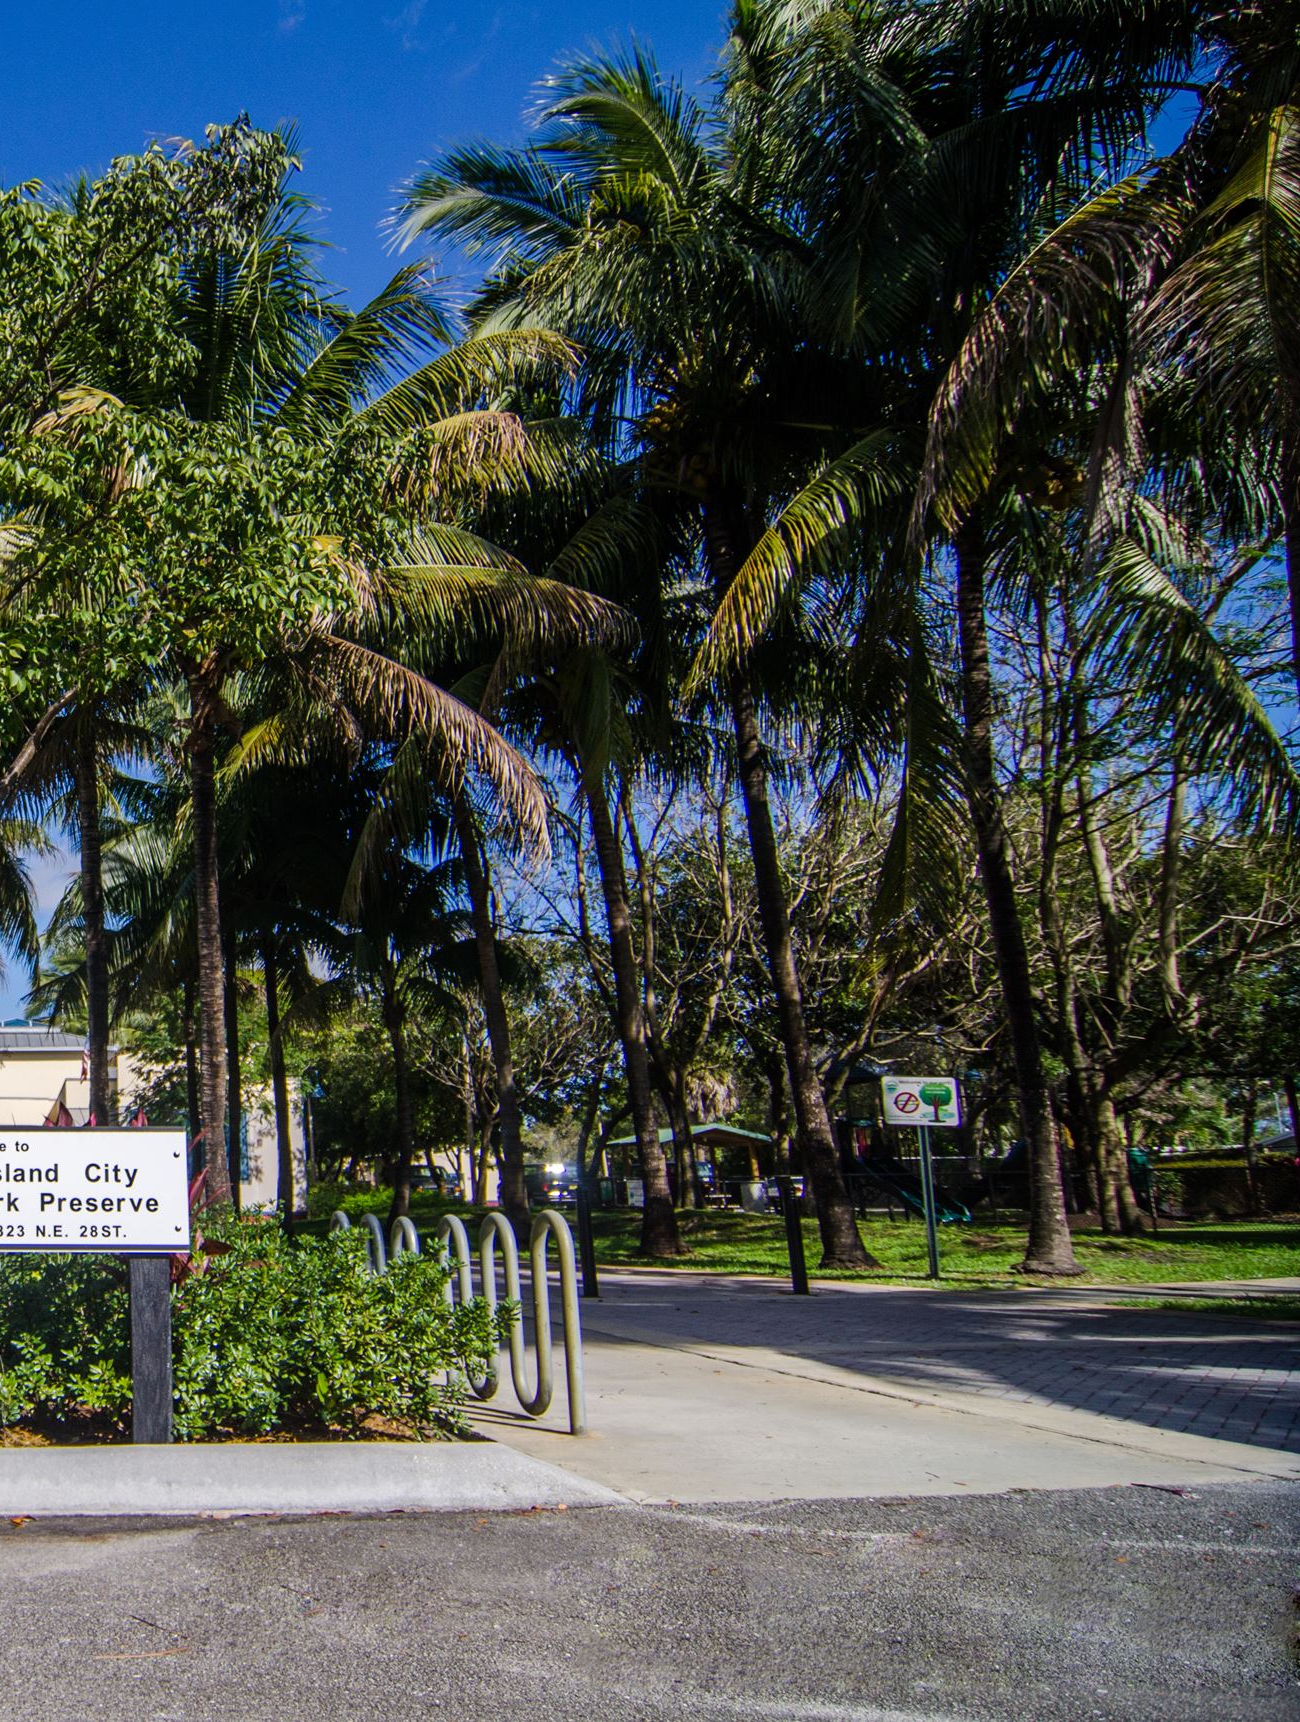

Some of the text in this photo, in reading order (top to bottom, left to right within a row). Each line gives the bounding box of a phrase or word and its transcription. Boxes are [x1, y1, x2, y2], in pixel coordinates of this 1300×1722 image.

[14, 1141, 30, 1152] to
[84, 1163, 138, 1188] City
[40, 1192, 159, 1213] Preserve
[35, 1224, 69, 1238] N.E.
